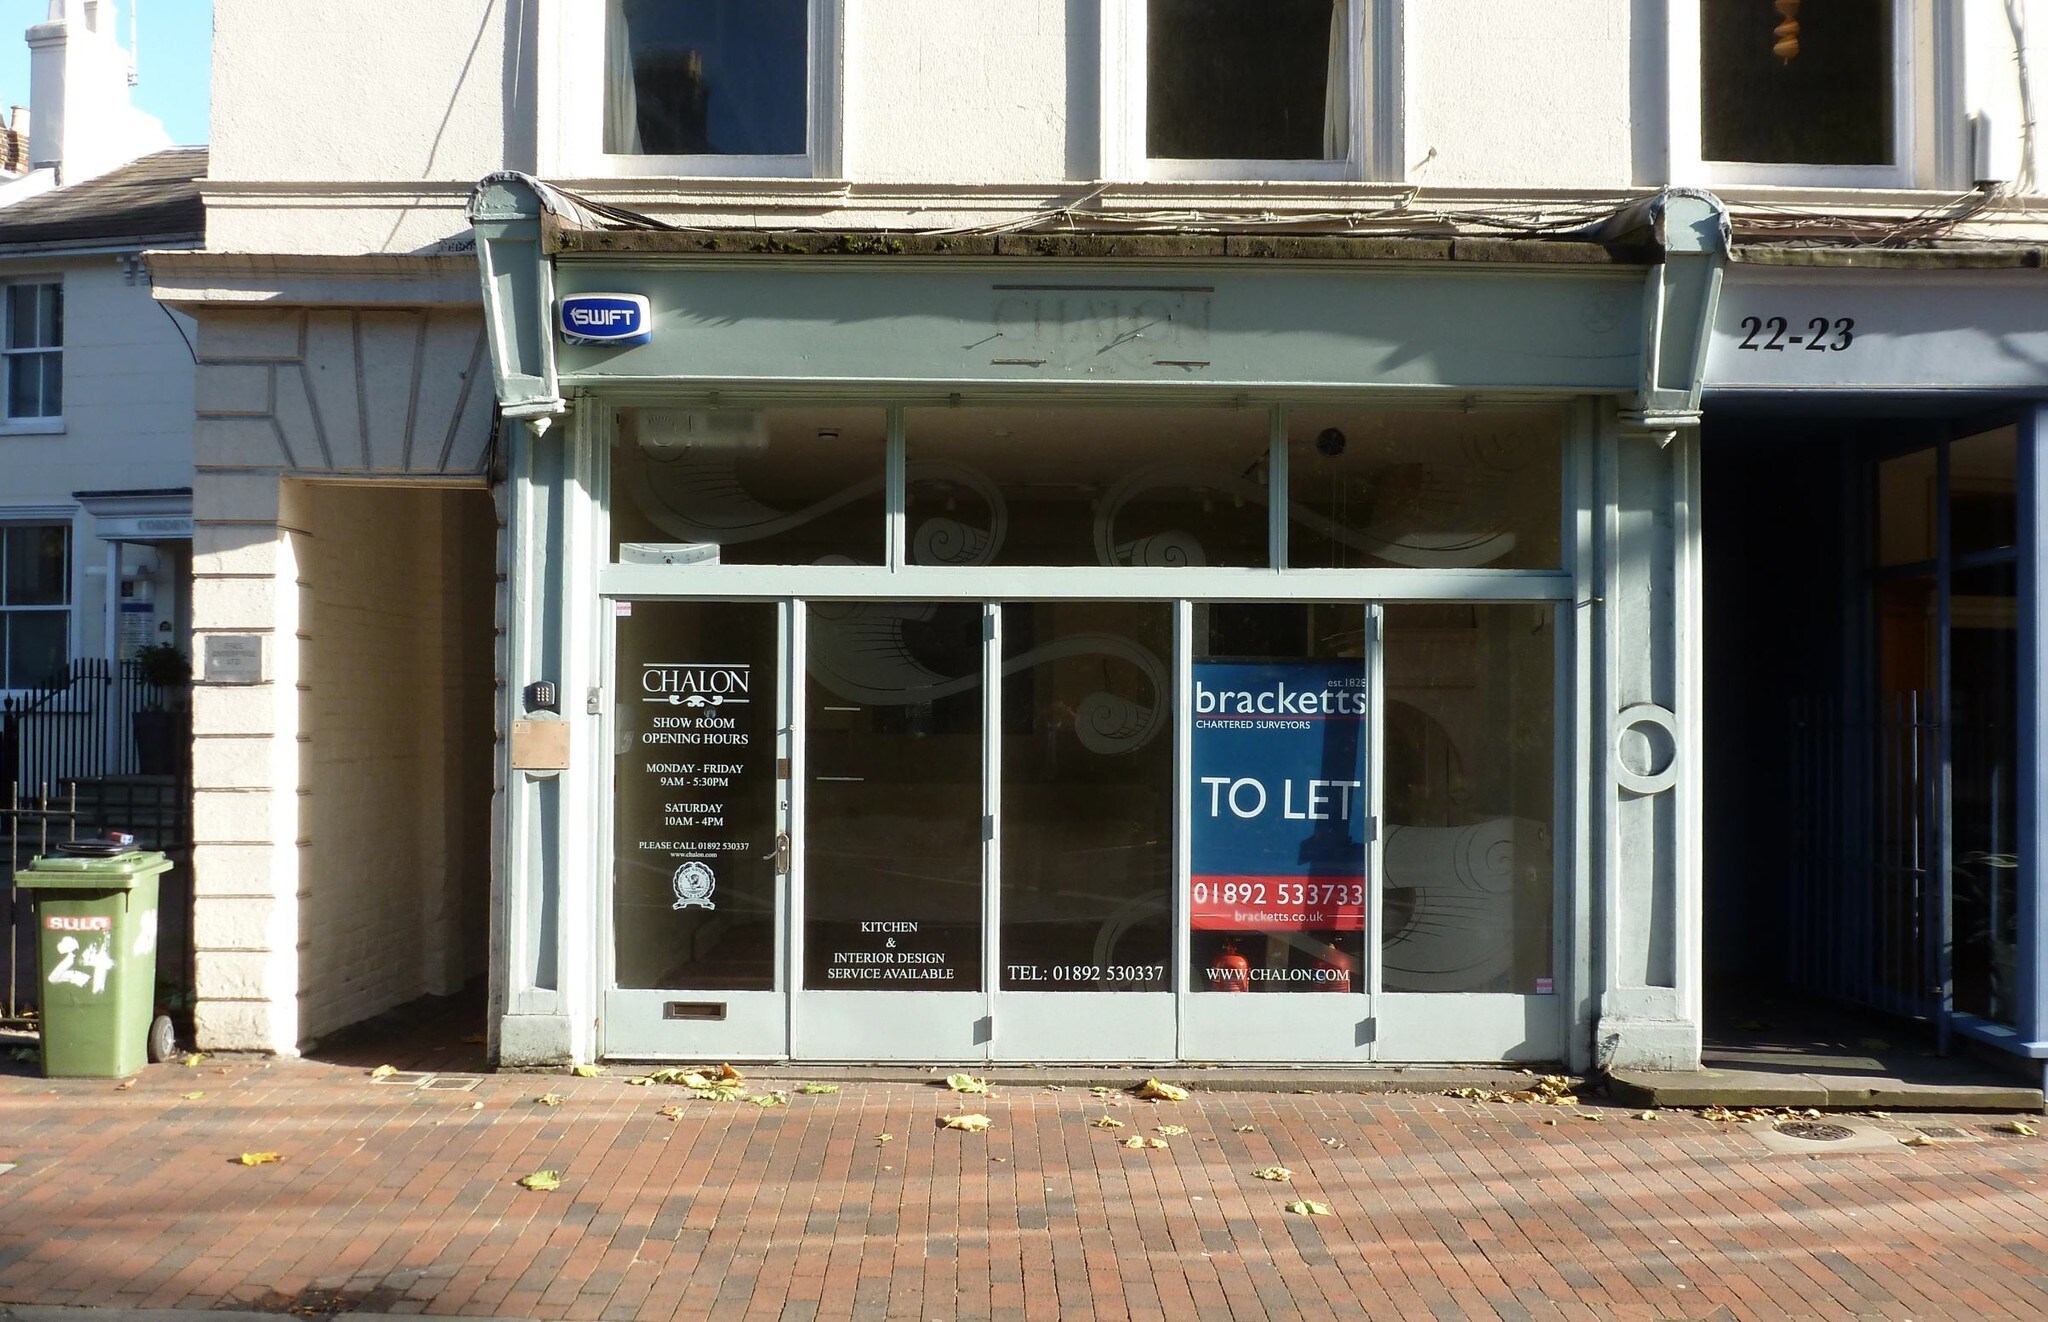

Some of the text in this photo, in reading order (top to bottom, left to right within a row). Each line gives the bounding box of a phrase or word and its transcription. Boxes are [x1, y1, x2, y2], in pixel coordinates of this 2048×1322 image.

[569, 306, 635, 327] SWIFT
[1738, 316, 1855, 352] 22-23
[642, 669, 750, 693] CHALON
[1195, 680, 1366, 715] bracketts
[652, 717, 735, 729] SHOW ROOM
[1195, 719, 1311, 730] CHARTERED SURVEYORS
[642, 732, 749, 745] OPENING HOURS
[646, 763, 695, 774] MONDAY
[703, 763, 744, 774] FRIDAY
[660, 776, 684, 787] 9AM
[692, 777, 729, 788] 5:30PM
[1200, 776, 1361, 821] TO LET
[664, 803, 723, 814] SATURDAY
[665, 816, 693, 827] 10AM
[701, 816, 724, 827] 4PM
[638, 841, 750, 851] PLEASE CALL 01892 530337
[670, 851, 718, 859] www.chalon.com
[1193, 882, 1363, 906] 01892 533733
[1233, 910, 1324, 923] bracketts.co.uk
[861, 921, 918, 933] KITCHEN
[885, 937, 897, 949] &
[47, 931, 116, 995] 24
[834, 952, 945, 965] INTERIOR DESIGN
[827, 967, 955, 980] SERVICE AVAILABLE
[1007, 964, 1164, 981] TEL: 01892 530337
[1206, 968, 1349, 981] WWW.CHALON.COM
